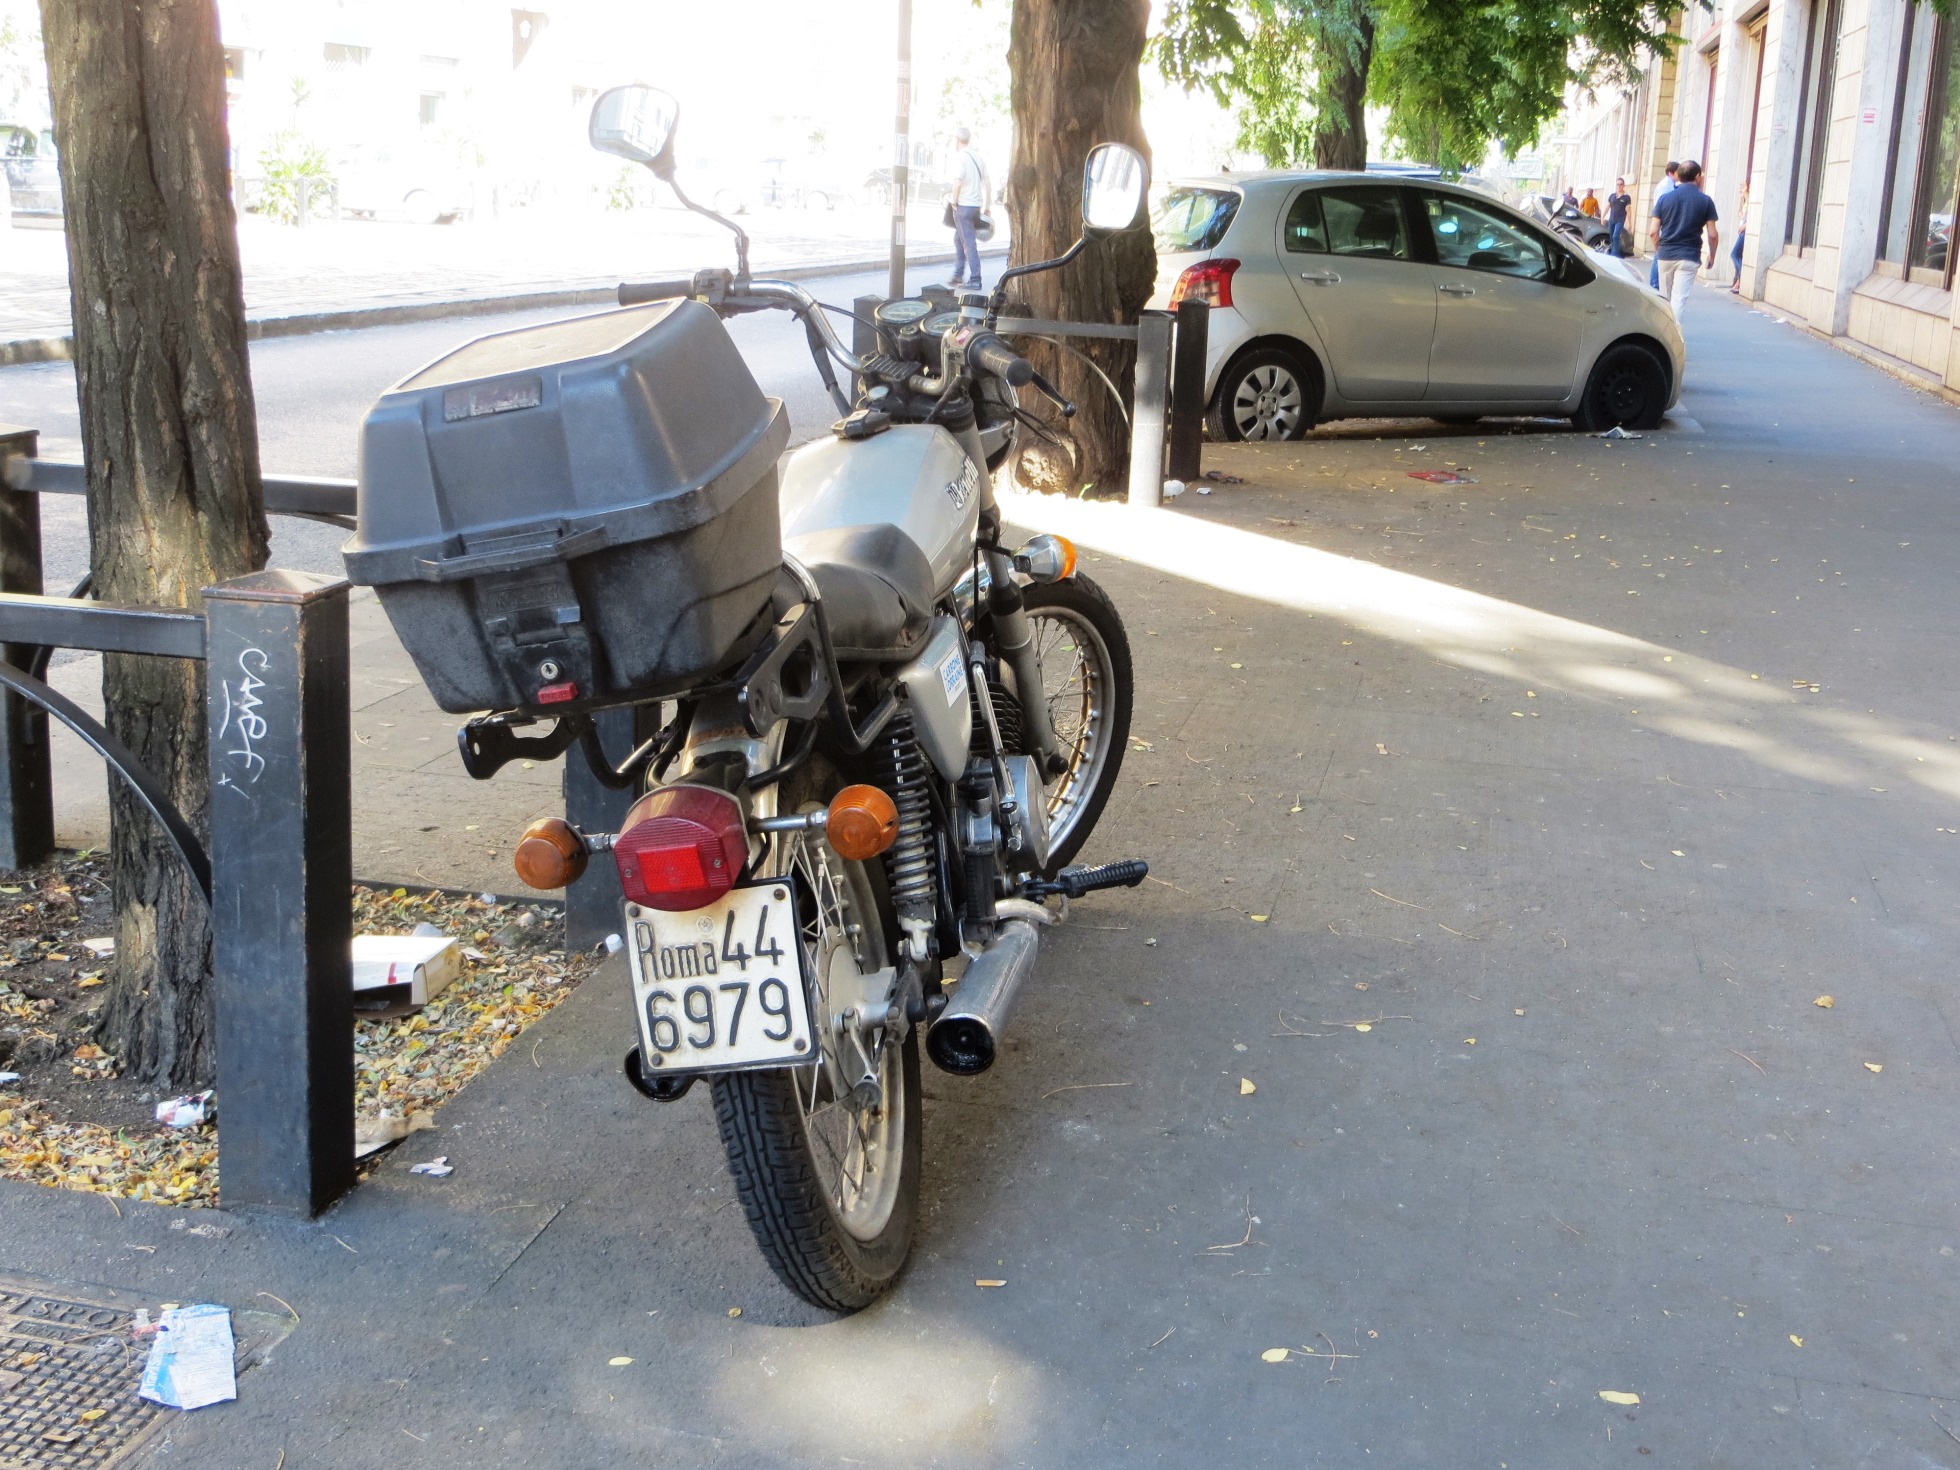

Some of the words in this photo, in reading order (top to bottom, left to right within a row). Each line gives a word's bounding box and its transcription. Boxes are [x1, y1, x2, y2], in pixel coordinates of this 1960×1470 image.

[635, 920, 719, 984] Roma
[721, 904, 785, 970] 44
[645, 977, 793, 1052] 6979
